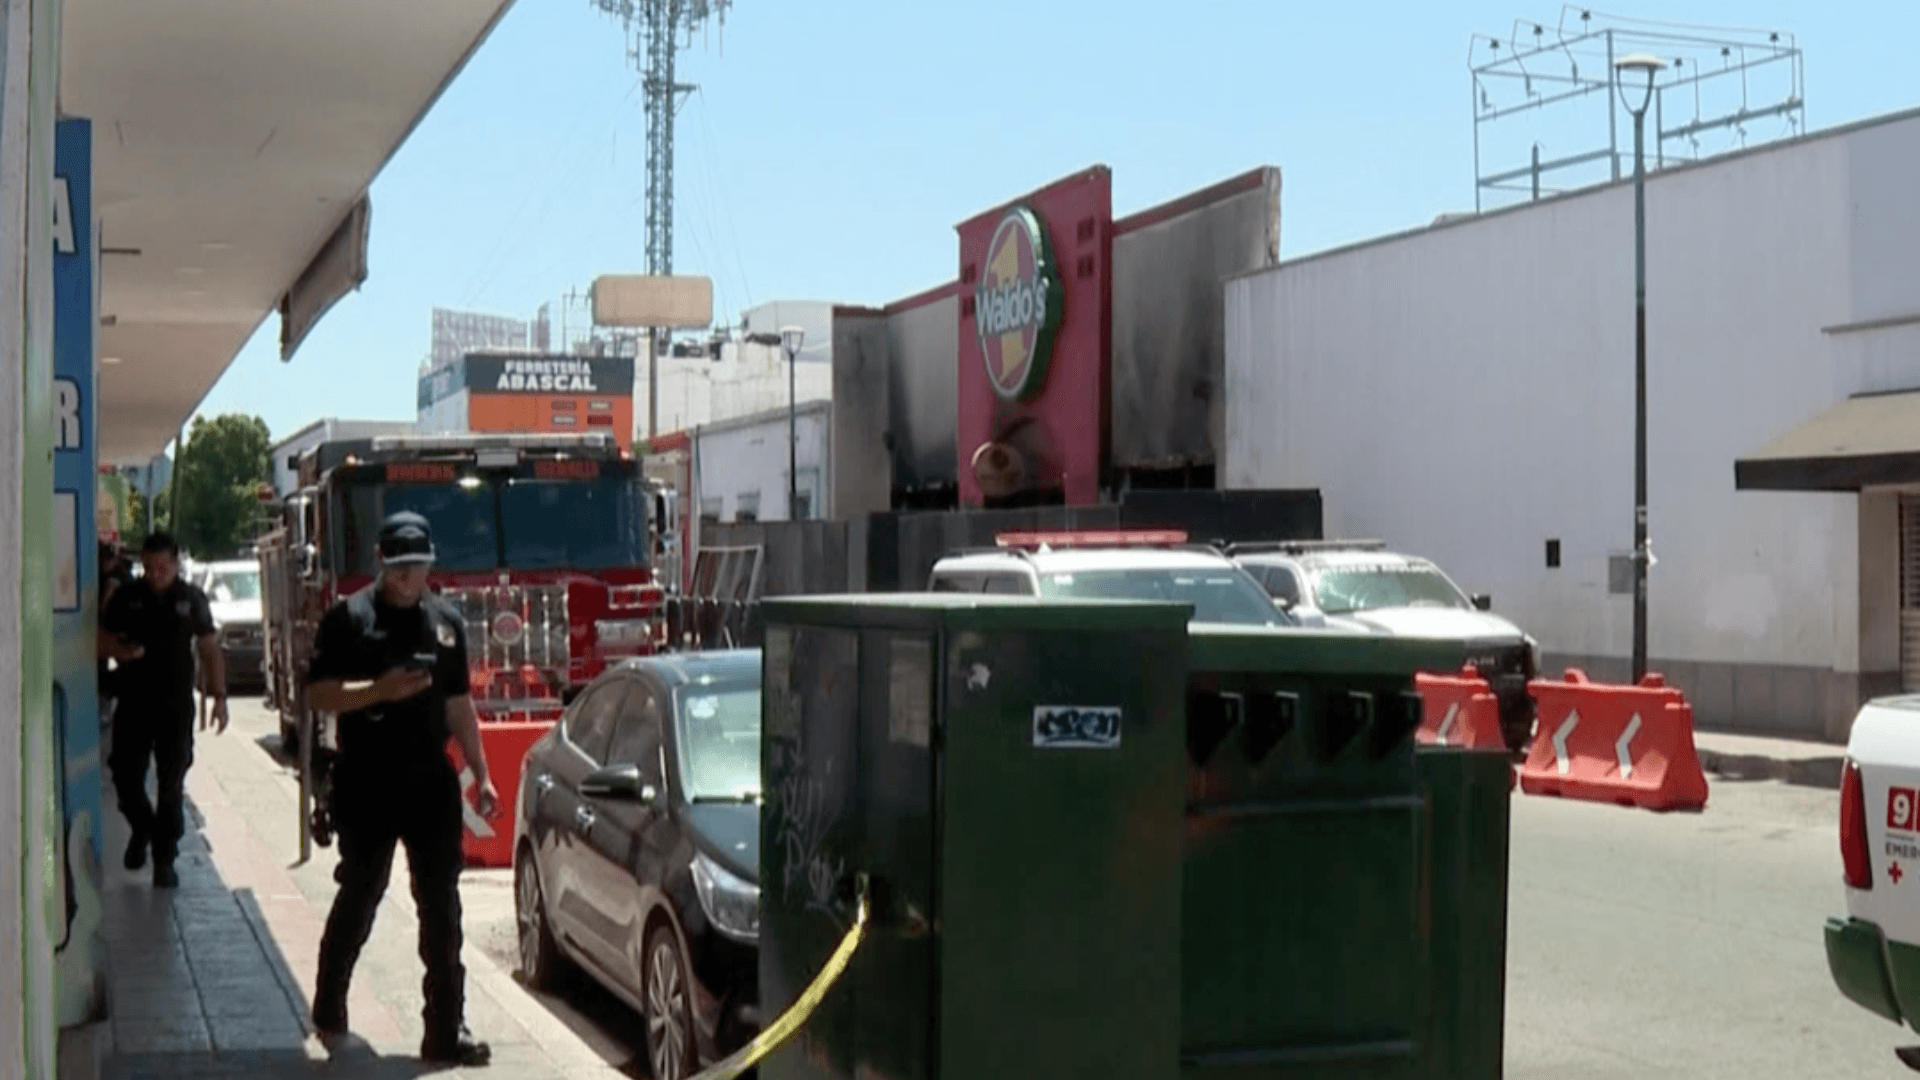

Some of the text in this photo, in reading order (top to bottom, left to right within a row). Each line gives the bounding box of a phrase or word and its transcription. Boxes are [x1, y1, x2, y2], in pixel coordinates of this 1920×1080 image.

[975, 275, 1047, 336] Waldo's
[497, 373, 598, 391] ABASCAL
[53, 380, 80, 448] R
